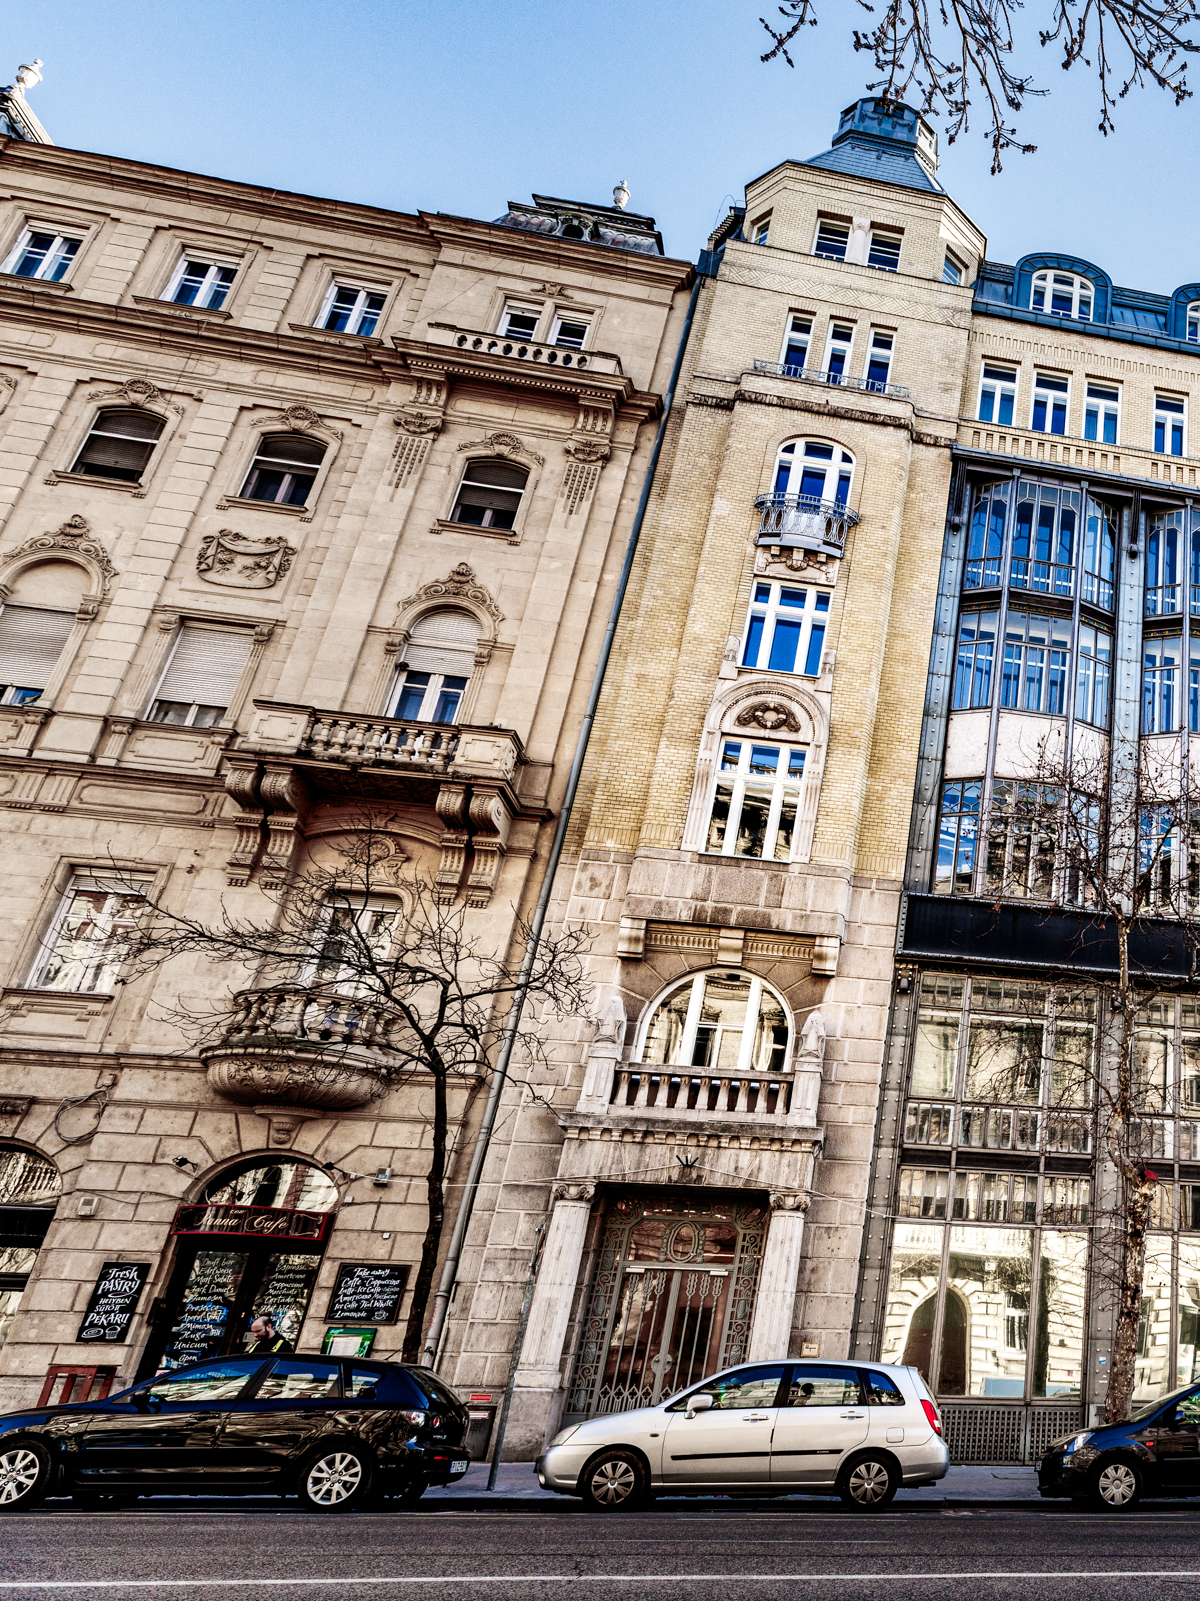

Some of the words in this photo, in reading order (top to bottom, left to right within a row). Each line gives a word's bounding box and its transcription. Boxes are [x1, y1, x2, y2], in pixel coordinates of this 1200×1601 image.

[244, 1214, 289, 1234] Cafe
[352, 1267, 370, 1278] Take
[173, 1341, 209, 1350] Unicum
